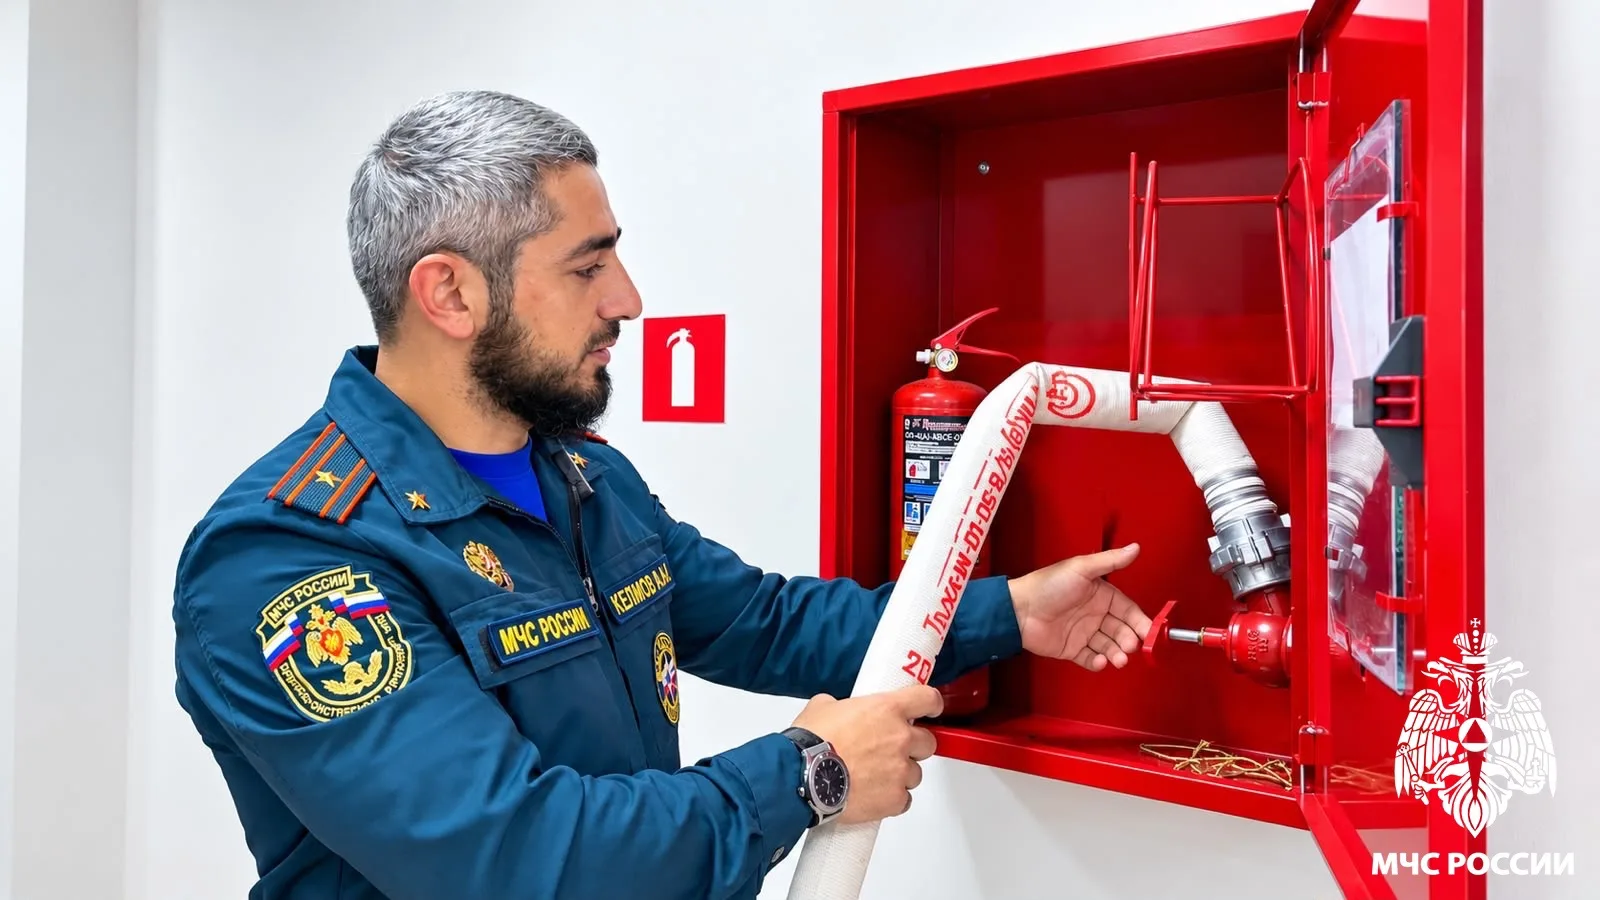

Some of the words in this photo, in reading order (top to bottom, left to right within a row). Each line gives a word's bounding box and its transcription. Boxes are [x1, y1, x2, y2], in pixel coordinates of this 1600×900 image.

[268, 598, 295, 621] МЧС
[294, 573, 348, 601] РОССИИ
[499, 620, 540, 655] МЧС
[538, 606, 591, 643] РОССИИ
